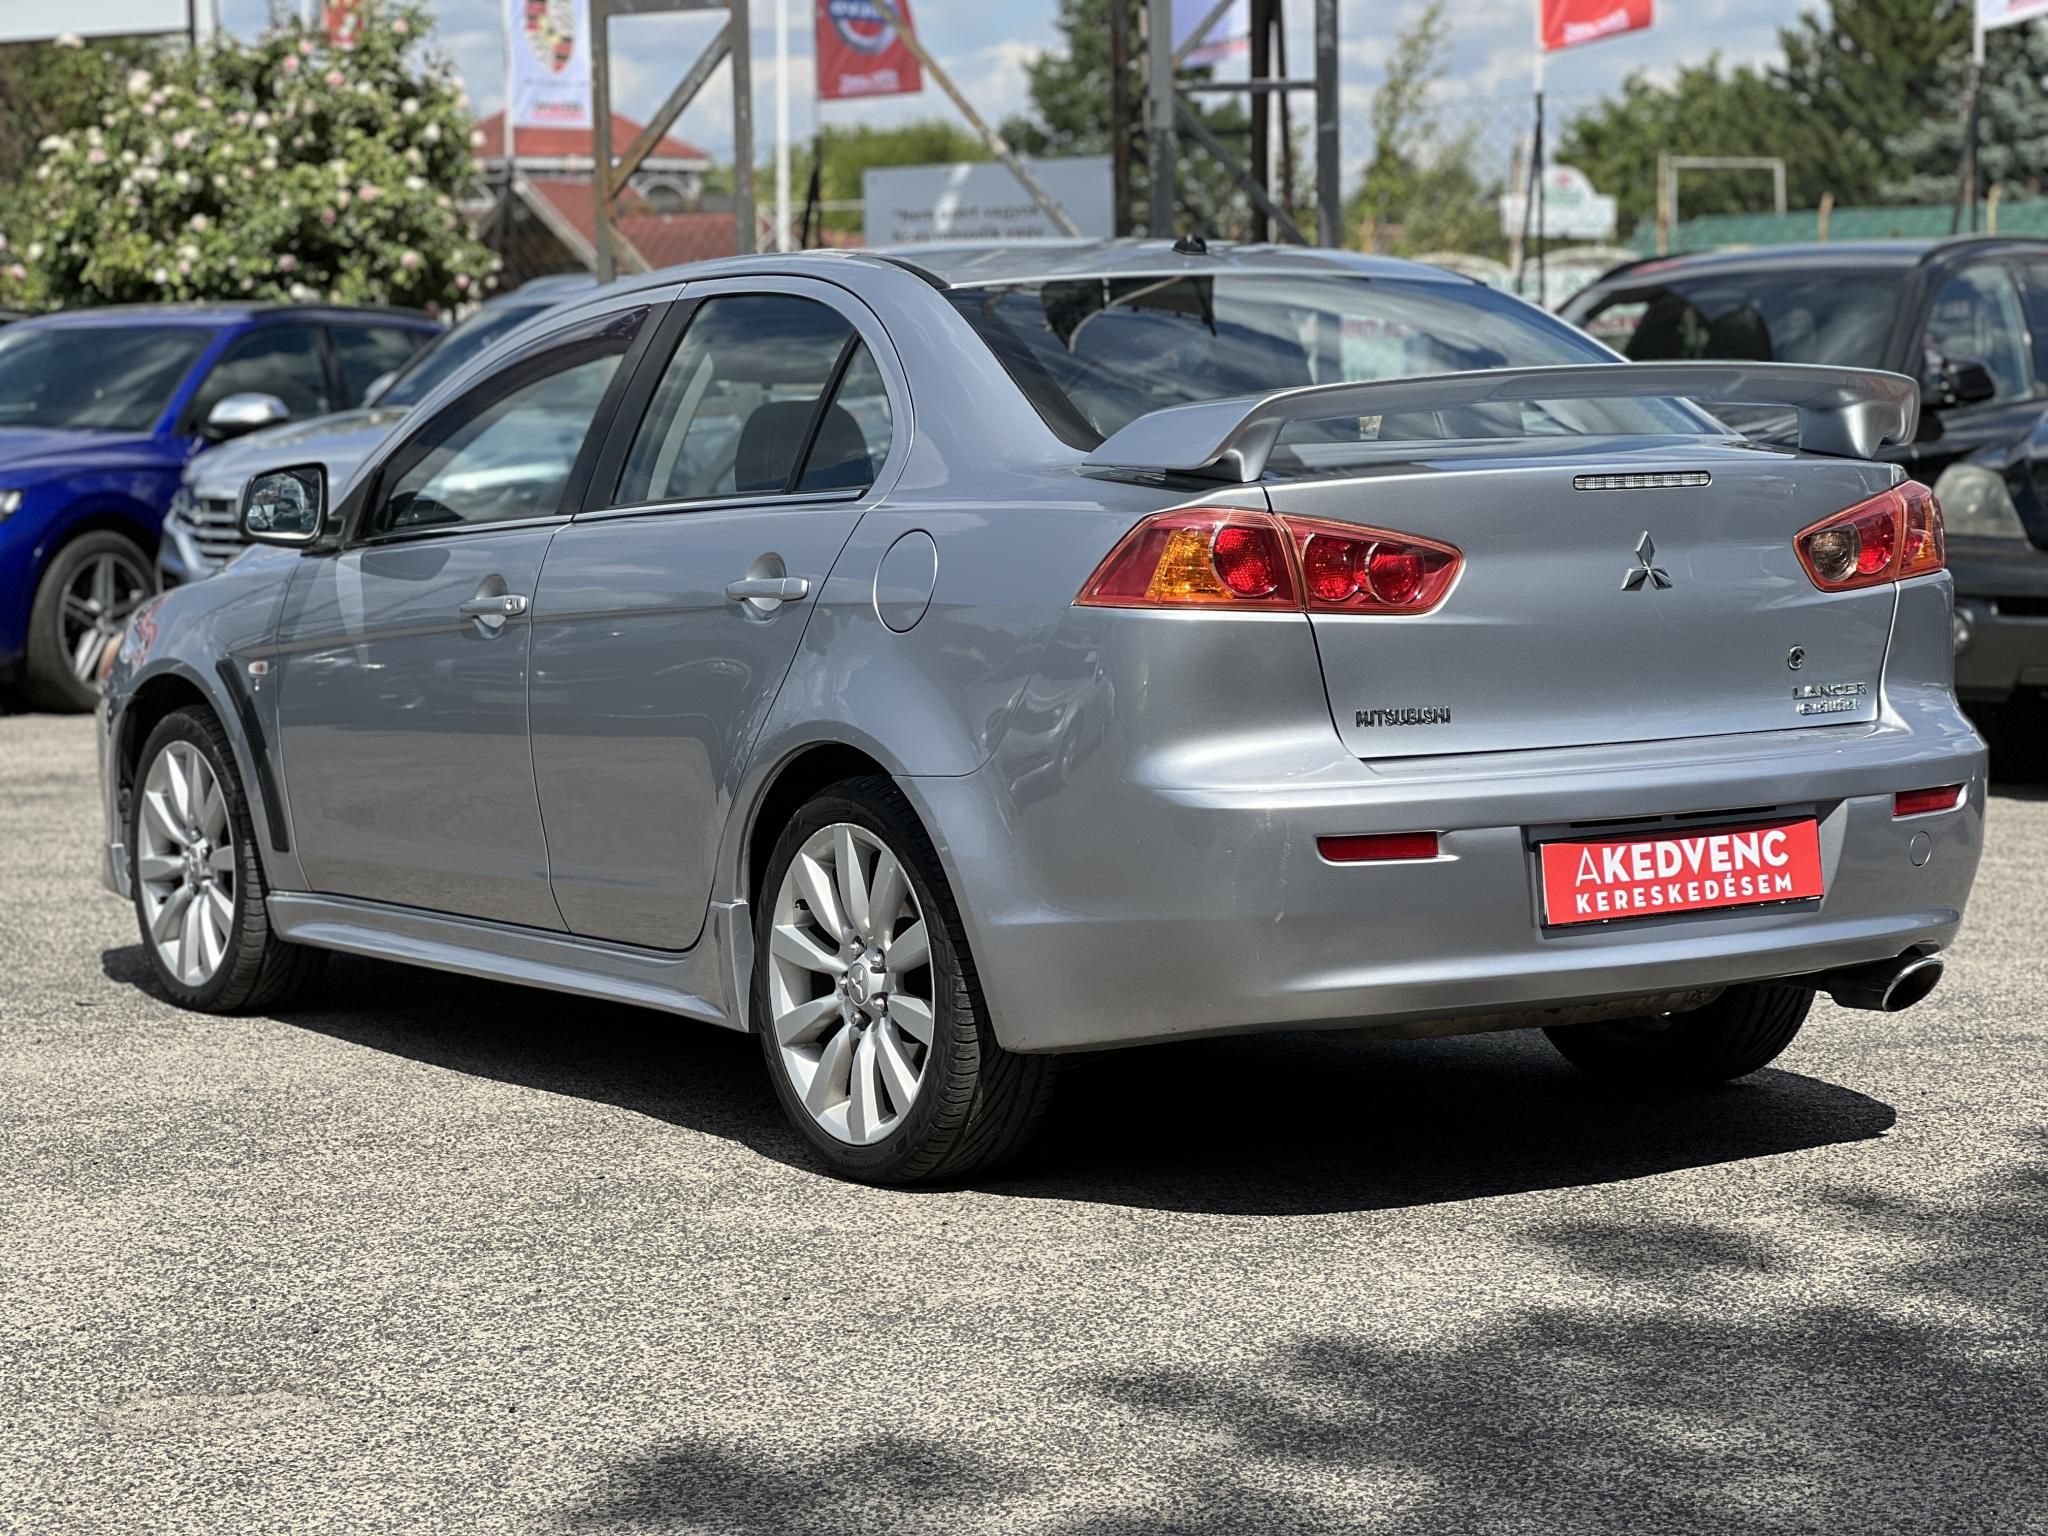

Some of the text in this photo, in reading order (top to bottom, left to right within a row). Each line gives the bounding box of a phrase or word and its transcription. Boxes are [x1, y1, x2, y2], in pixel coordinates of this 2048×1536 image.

[1792, 682, 1867, 700] LANCER
[1355, 706, 1451, 727] MITSUBISHI
[1576, 872, 1793, 914] KERESKEDÉSEM
